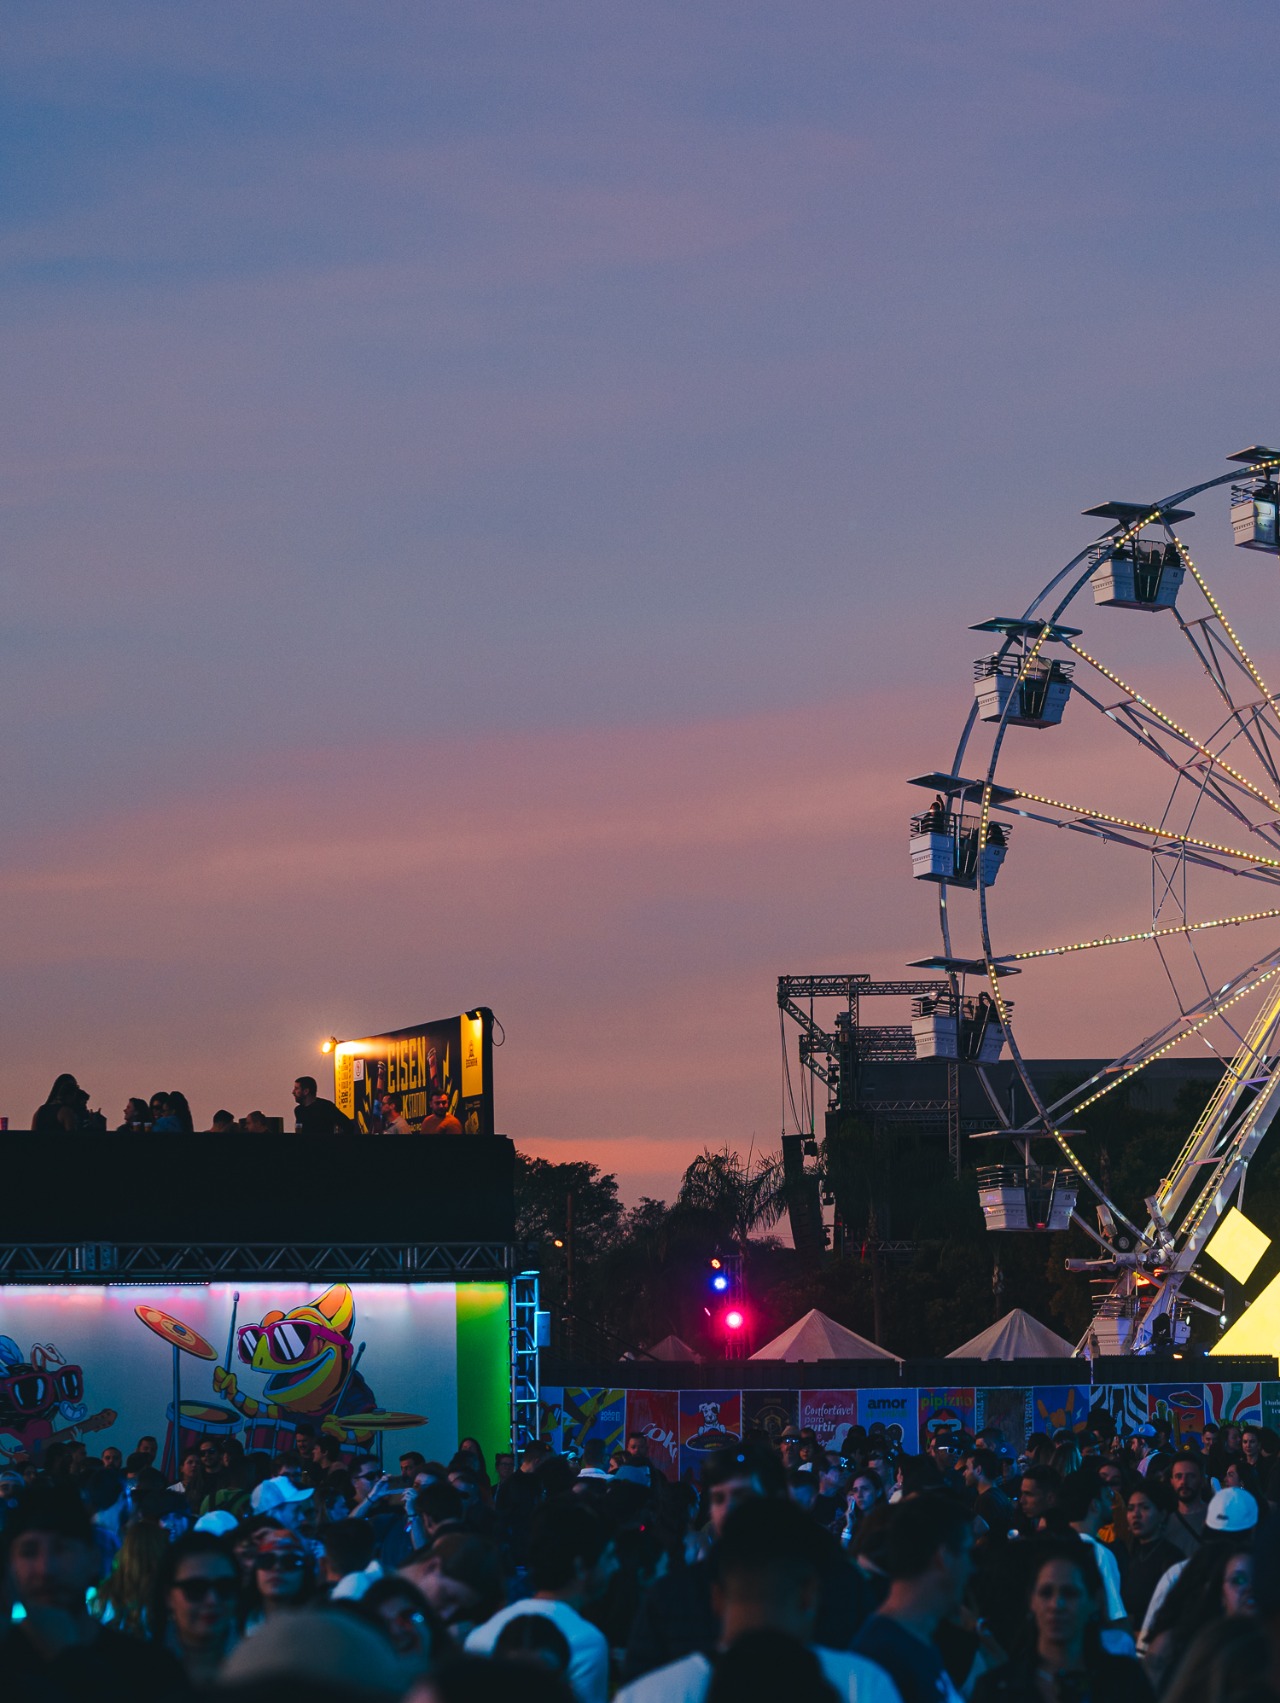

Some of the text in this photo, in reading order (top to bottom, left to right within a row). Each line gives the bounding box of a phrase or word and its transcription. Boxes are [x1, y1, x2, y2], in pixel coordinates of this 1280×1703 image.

[387, 1036, 427, 1093] EISEN
[804, 1402, 854, 1417] Confortável
[868, 1399, 907, 1409] amor
